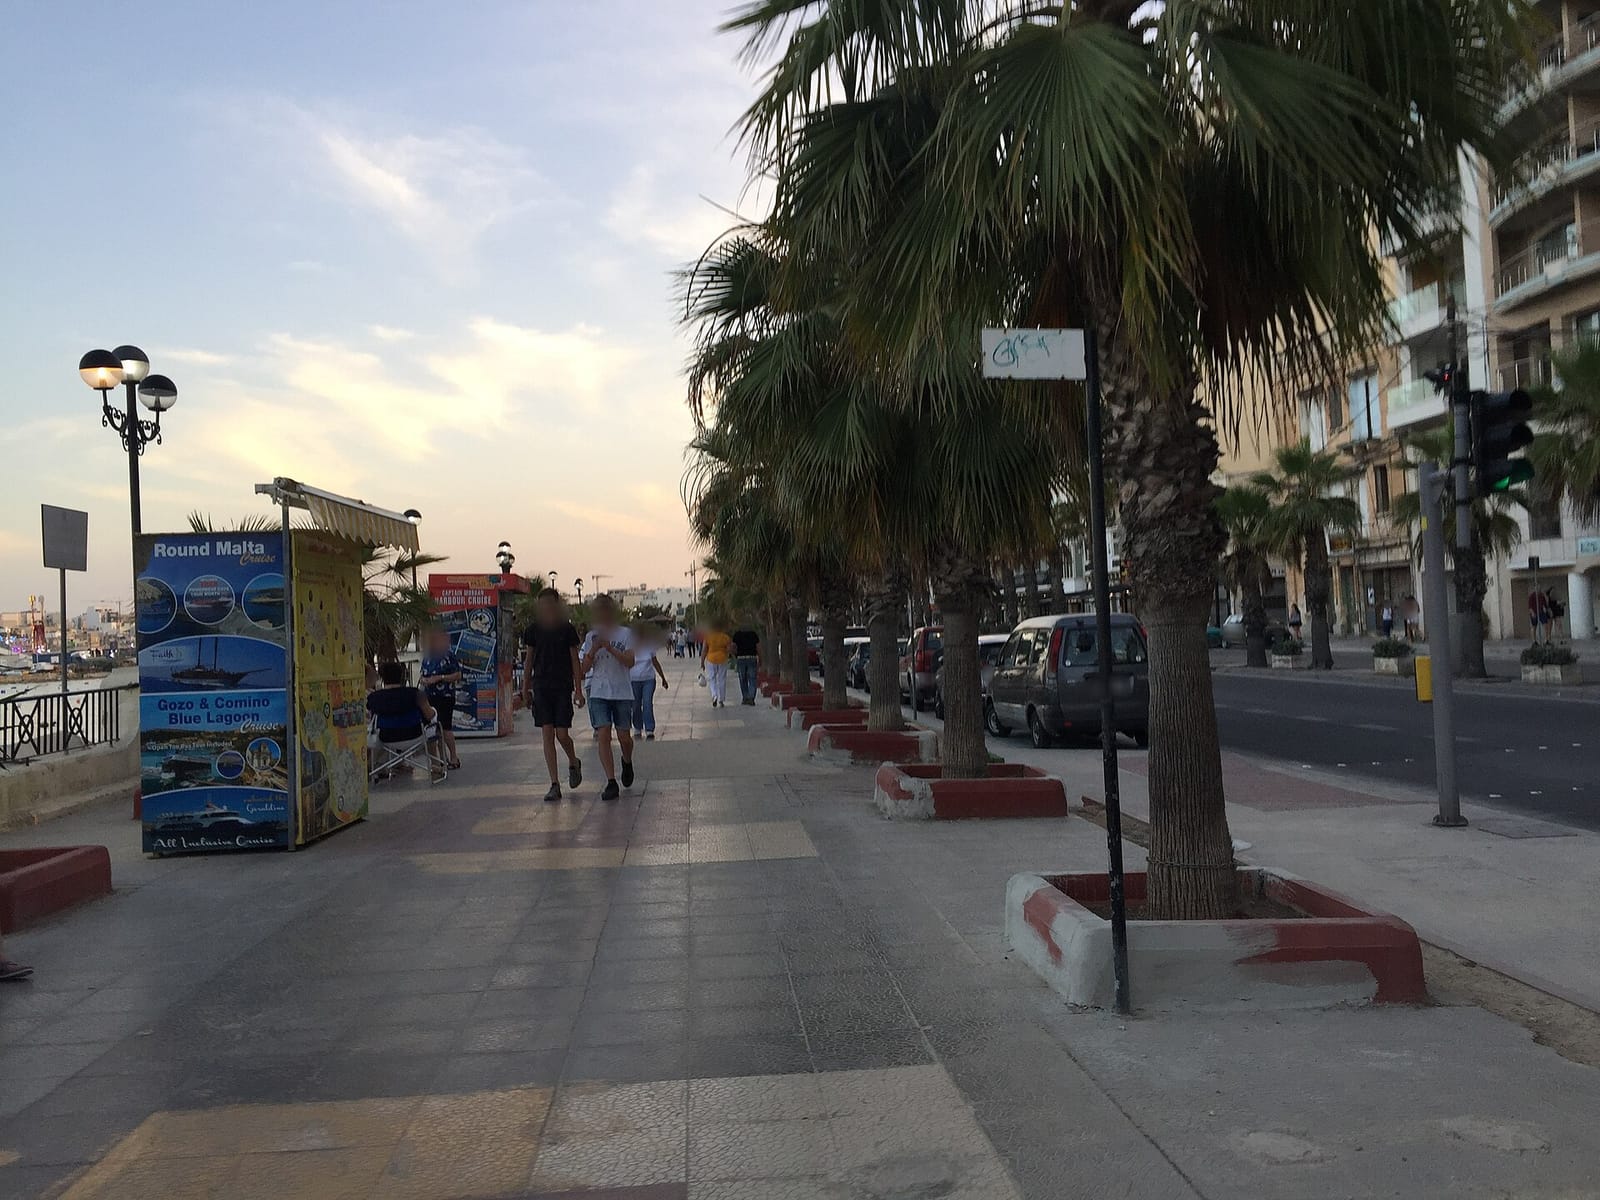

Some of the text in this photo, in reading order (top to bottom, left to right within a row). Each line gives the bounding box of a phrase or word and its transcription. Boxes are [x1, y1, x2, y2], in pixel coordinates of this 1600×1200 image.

[154, 540, 265, 557] Round Malta
[239, 551, 276, 566] Cruise
[157, 696, 270, 711] Gozo & Comino
[168, 711, 260, 725] Blue Lagoon
[240, 719, 279, 734] Cruise
[235, 835, 275, 848] Cruise
